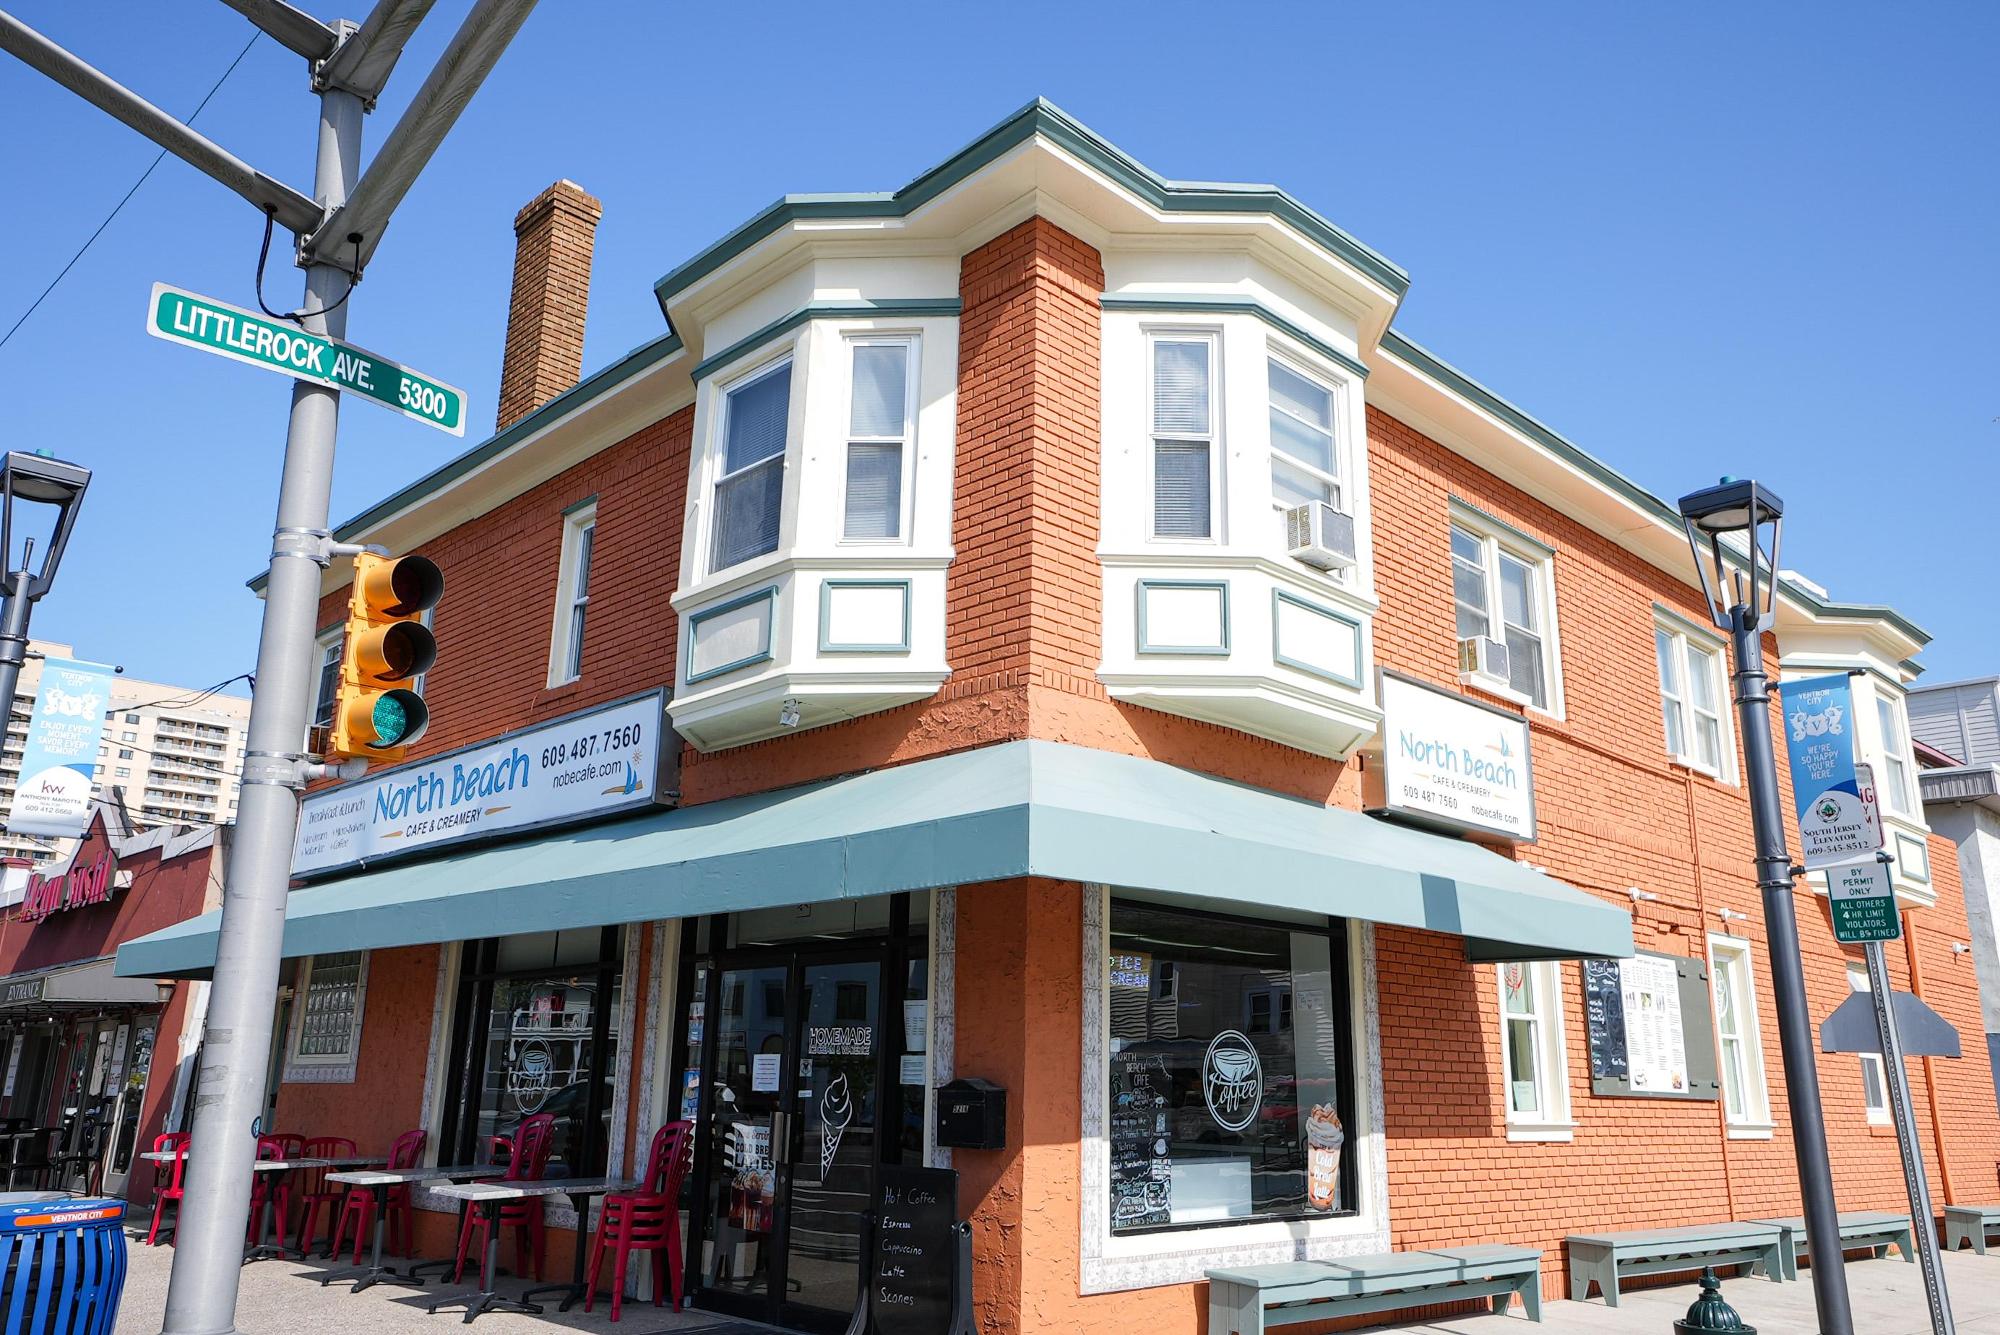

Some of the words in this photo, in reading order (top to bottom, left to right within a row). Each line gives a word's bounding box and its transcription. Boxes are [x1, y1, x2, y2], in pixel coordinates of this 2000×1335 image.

[173, 300, 324, 373] LITTLEROCK
[331, 351, 375, 391] AVE.
[398, 377, 447, 420] 5300
[1799, 689, 1830, 700] VENTNOR
[1807, 696, 1823, 705] CITY
[541, 723, 642, 769] 609.487.7560
[1807, 743, 1832, 754] WE'RE
[1400, 729, 1458, 773] North
[1463, 747, 1517, 790] Beach
[1801, 755, 1812, 765] SO
[1813, 750, 1839, 763] HAPPY
[1806, 760, 1836, 772] YOU'RE
[553, 759, 622, 789] nobecafe.com
[373, 771, 445, 824] North
[450, 747, 531, 806] Beach
[1433, 774, 1450, 788] CAFE
[1451, 779, 1457, 788] &
[1457, 781, 1491, 798] CREAMERY
[20, 793, 51, 803] ANTHONY
[52, 796, 82, 805] MAROTTA
[25, 805, 39, 814] 609
[405, 823, 427, 839] CAFE
[429, 820, 436, 833] &
[436, 806, 483, 831] CREAMERY
[1807, 841, 1869, 856] 609-545-8512
[1851, 869, 1863, 877] BY
[1843, 877, 1874, 887] PERMIT
[1849, 887, 1871, 896] ONLY
[1840, 900, 1855, 909] ALL
[1857, 898, 1886, 909] OTHERS
[1843, 910, 1850, 919] 4
[1851, 910, 1864, 918] HR
[1865, 908, 1884, 918] LIMIT
[1846, 919, 1887, 929] VIOLATORS
[1839, 930, 1858, 939] WILL
[1873, 928, 1897, 938] FINED
[1120, 955, 1142, 971] ICE
[7, 981, 41, 999] ENTRANCE
[809, 1027, 872, 1046] HOMEMADE
[1126, 1063, 1146, 1073] BEACH
[1134, 1074, 1150, 1086] CAFE
[1209, 1069, 1258, 1112] Coffee
[884, 1186, 901, 1204] Hot
[907, 1188, 936, 1205] Coffee
[51, 1212, 88, 1223] VENTNOR
[88, 1211, 104, 1219] CITY
[882, 1216, 912, 1229] Espresso
[881, 1239, 923, 1256] Cappuccino
[881, 1264, 905, 1278] Latte
[880, 1286, 915, 1306] Scones
